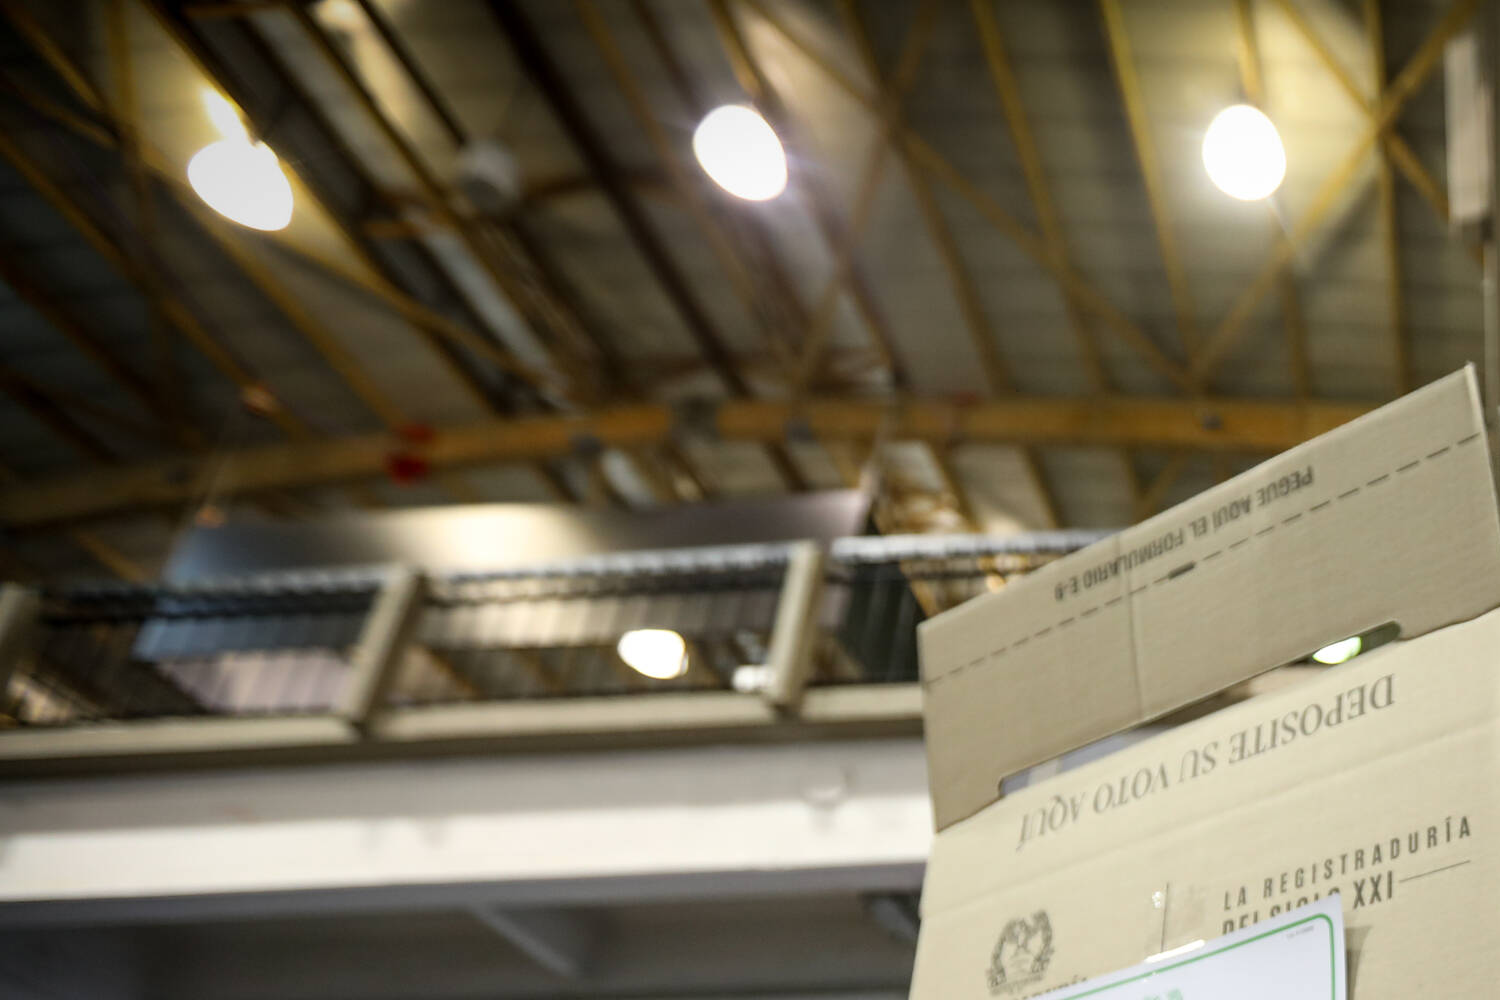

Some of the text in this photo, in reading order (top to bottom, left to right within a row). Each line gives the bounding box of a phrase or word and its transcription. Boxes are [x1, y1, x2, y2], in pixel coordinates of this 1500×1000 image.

[1257, 466, 1314, 506] PEGUE
[1190, 517, 1208, 538] EL
[1083, 529, 1185, 588] FORMULARIO
[1229, 673, 1395, 764] DEPOSITE
[1178, 742, 1219, 784] SU
[1093, 767, 1169, 814] VOTO
[1223, 886, 1247, 911] LA
[1263, 816, 1471, 898] REGISTRADURÍA
[1352, 870, 1394, 910] XXI
